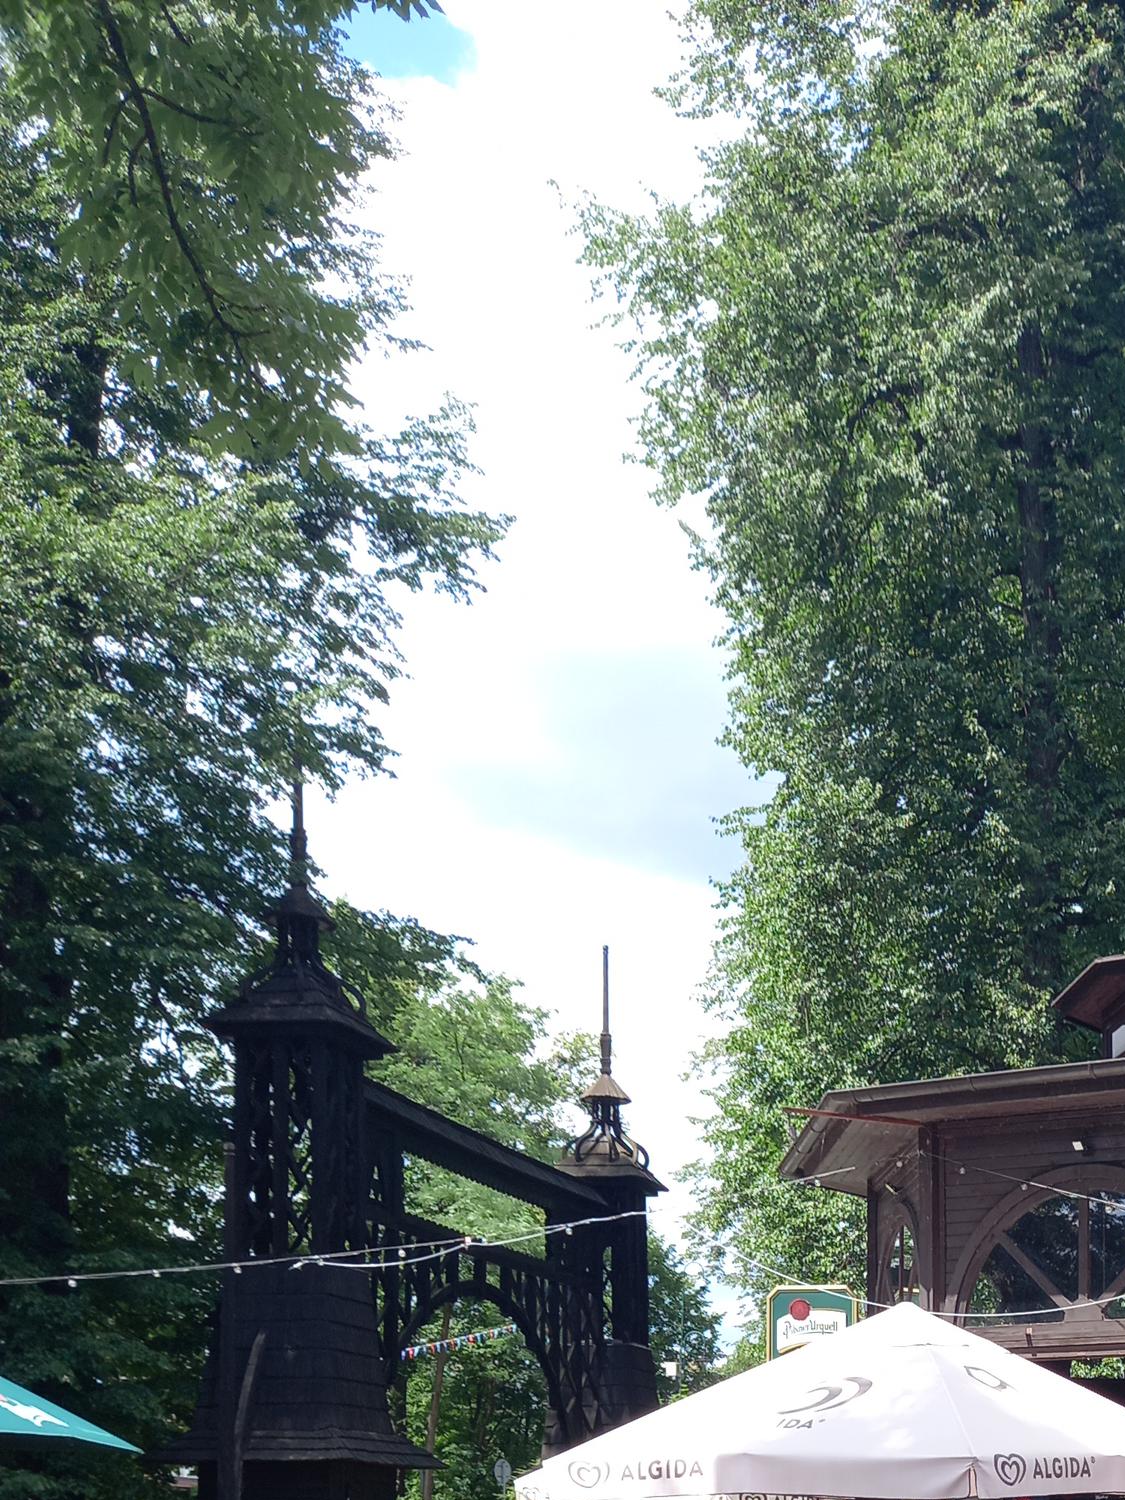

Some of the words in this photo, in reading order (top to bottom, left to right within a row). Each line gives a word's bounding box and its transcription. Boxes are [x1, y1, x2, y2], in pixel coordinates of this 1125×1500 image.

[809, 1319, 838, 1335] Urquell
[621, 1459, 703, 1481] ALGIDA
[1033, 1457, 1091, 1479] ALGIDA
